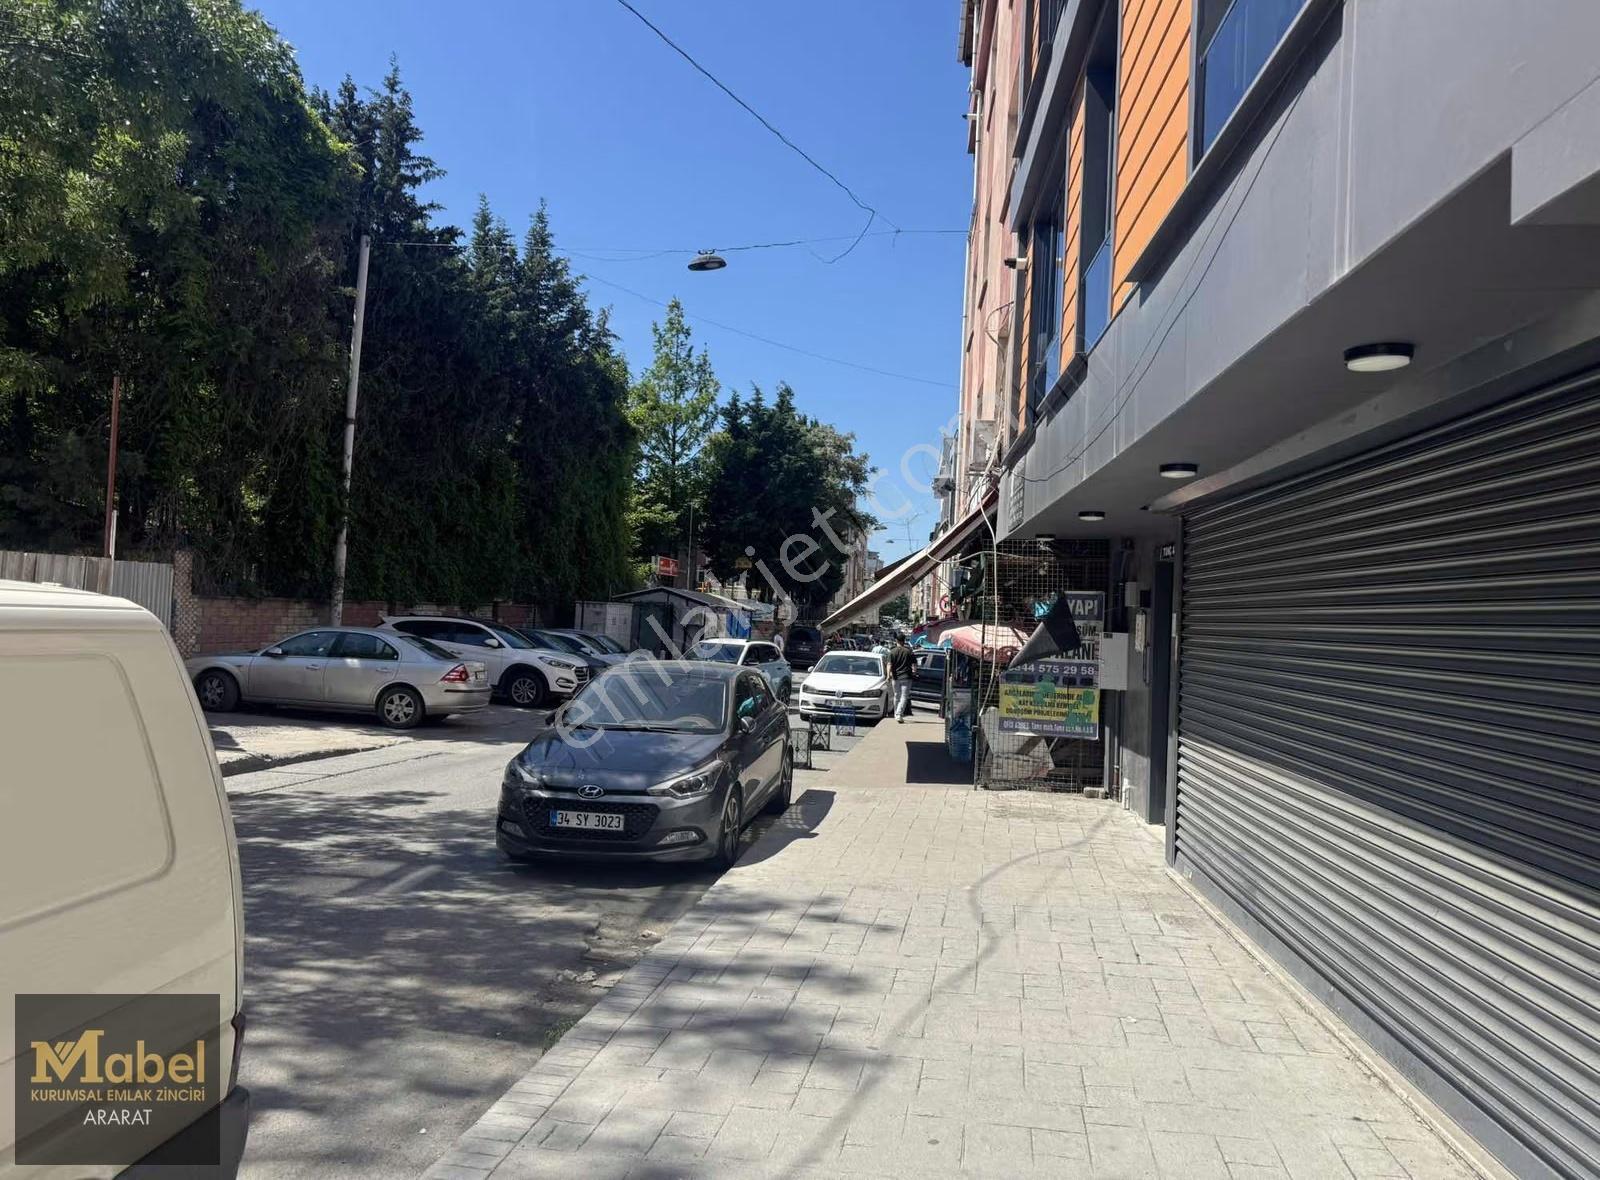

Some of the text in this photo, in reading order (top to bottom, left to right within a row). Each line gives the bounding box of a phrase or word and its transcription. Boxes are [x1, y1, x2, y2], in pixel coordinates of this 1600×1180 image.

[1068, 599, 1098, 616] YAPI
[1038, 664, 1060, 674] 575
[1063, 665, 1078, 676] 29
[1081, 666, 1095, 676] 58
[558, 812, 621, 828] 34 SY 3023
